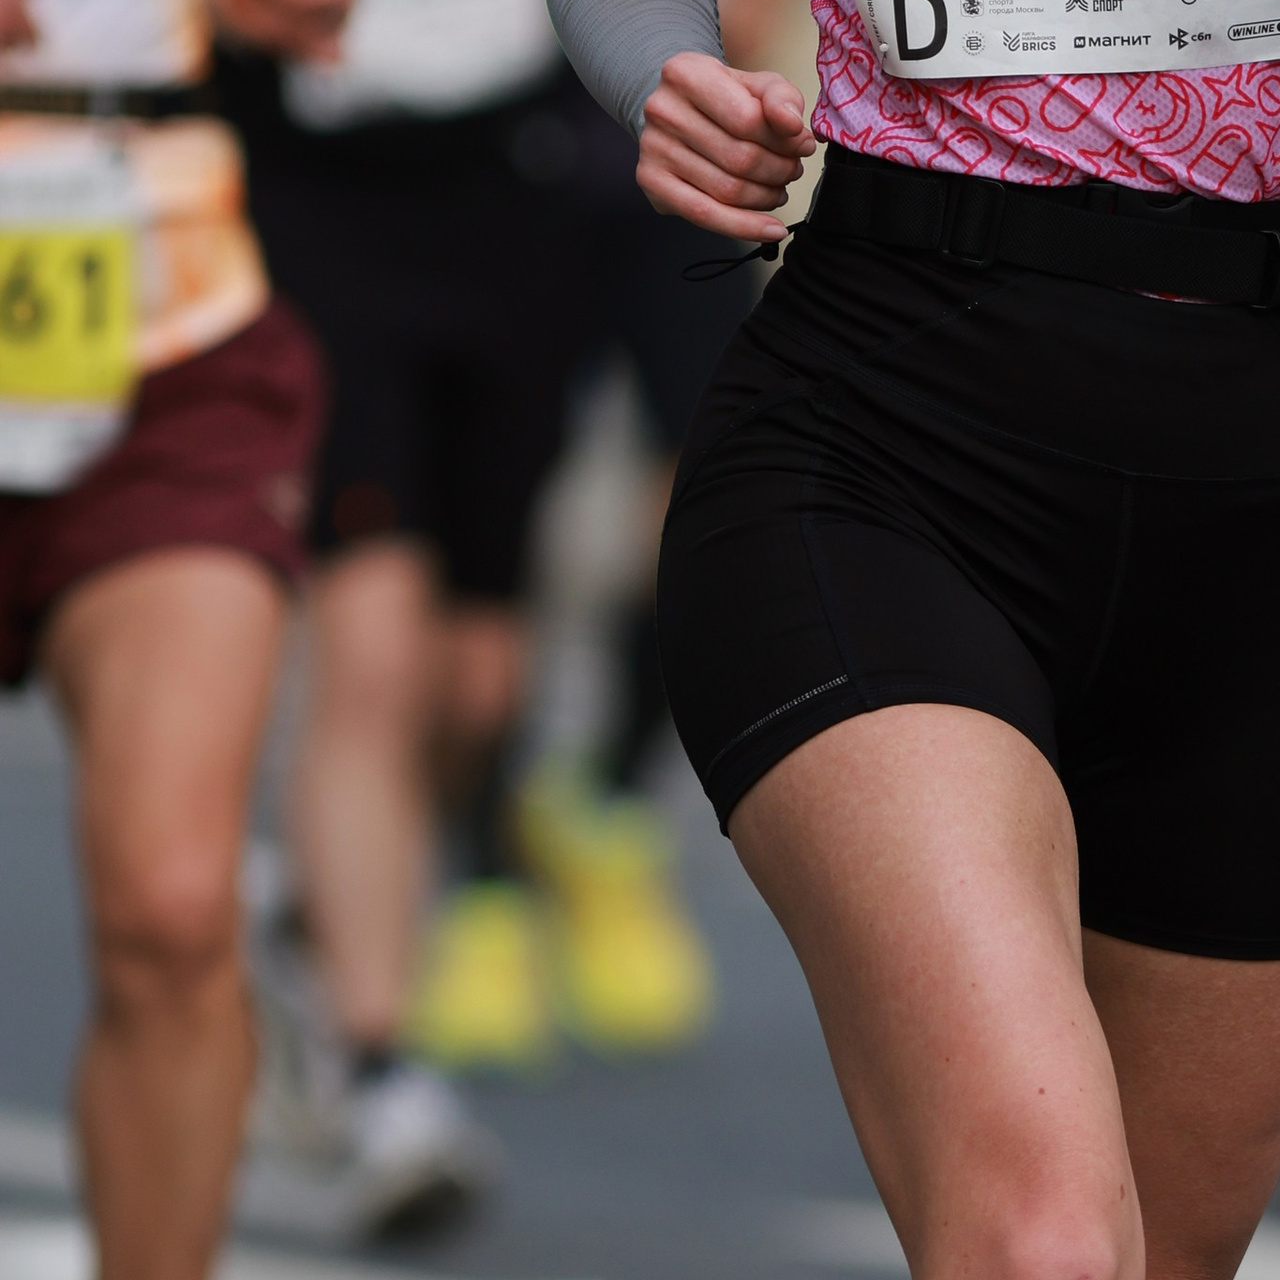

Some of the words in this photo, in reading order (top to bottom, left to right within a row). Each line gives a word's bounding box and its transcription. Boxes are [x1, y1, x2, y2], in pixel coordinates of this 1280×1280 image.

[988, 0, 1014, 7] спорта
[988, 6, 1014, 15] города
[1015, 5, 1045, 14] Москвы
[1232, 23, 1276, 38] WINLINE
[1088, 35, 1152, 48] магнит
[1190, 32, 1212, 42] сбп
[1021, 41, 1057, 52] BRICS
